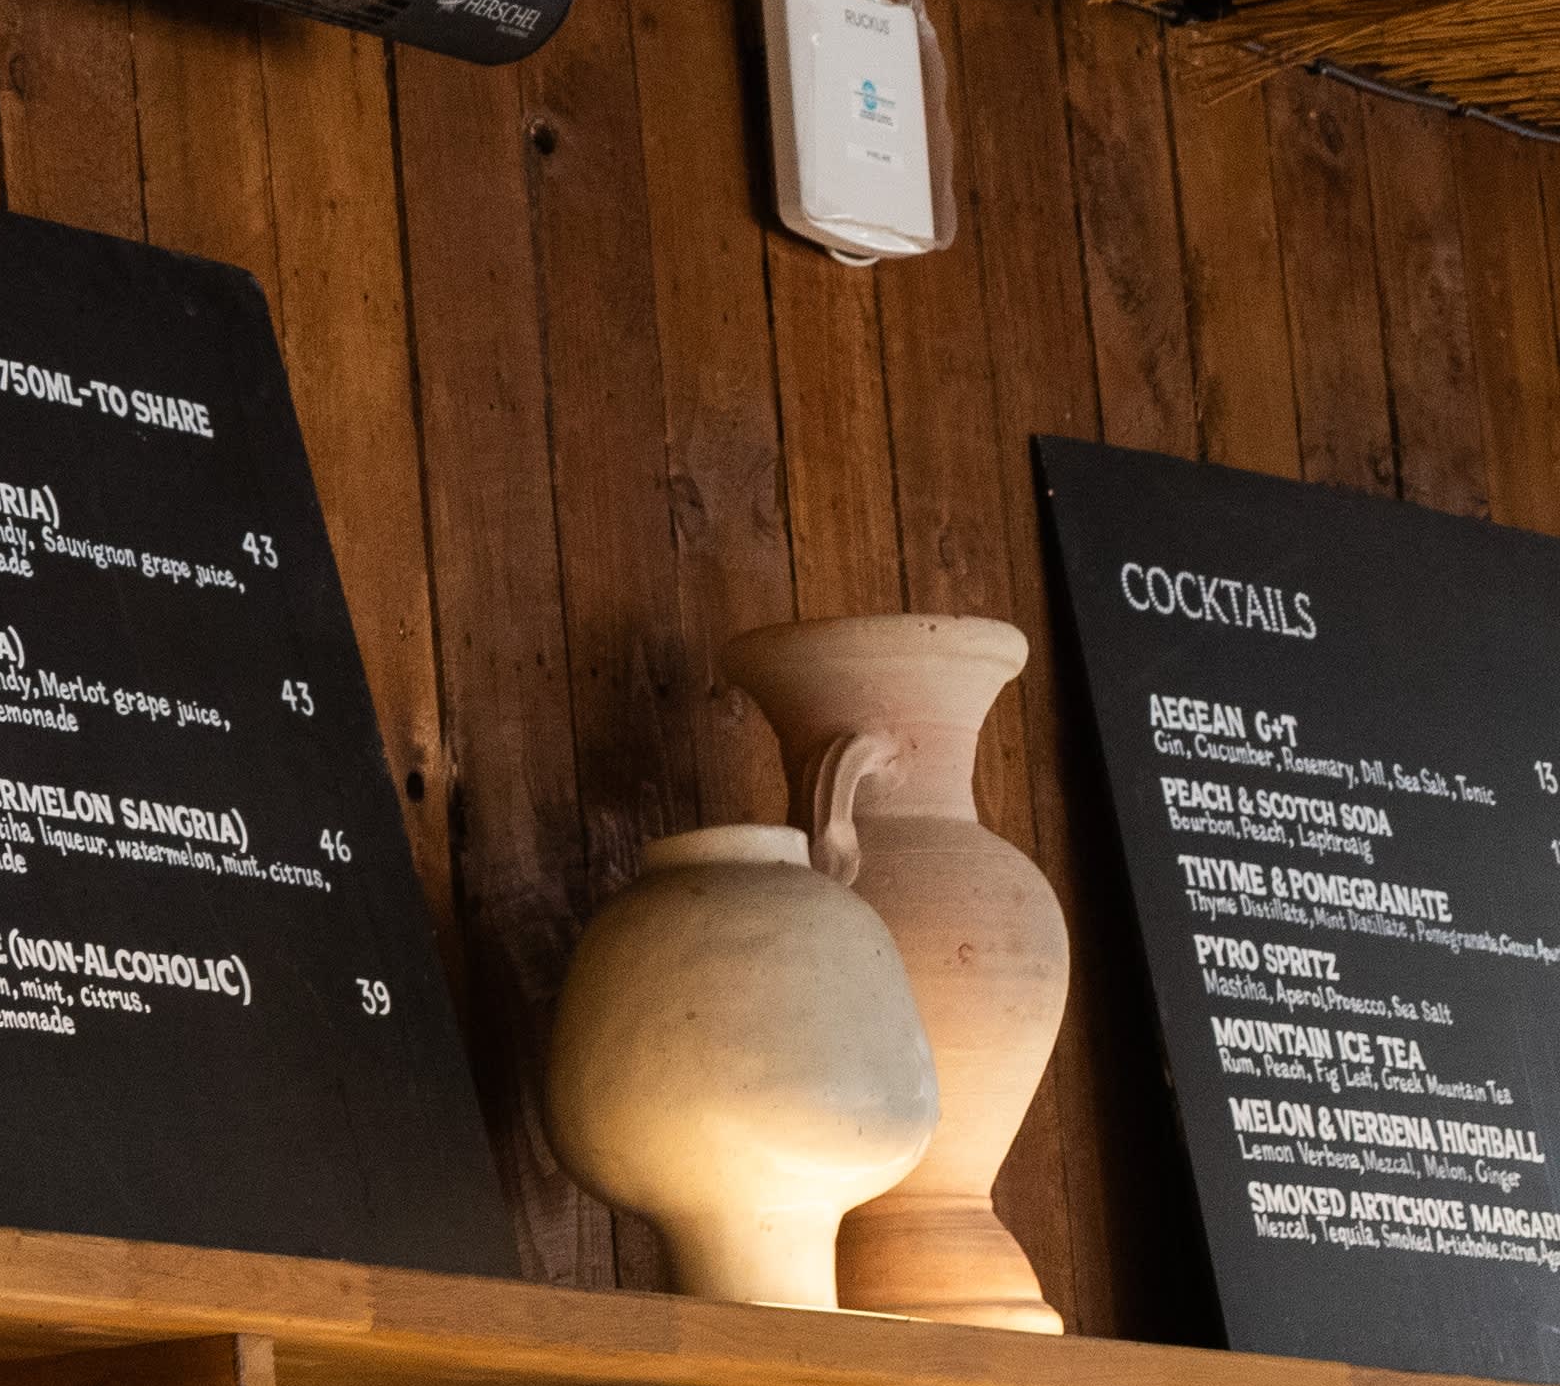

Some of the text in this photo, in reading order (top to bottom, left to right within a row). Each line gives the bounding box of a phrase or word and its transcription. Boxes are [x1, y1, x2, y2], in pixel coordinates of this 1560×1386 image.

[131, 390, 213, 437] SHARE
[243, 532, 278, 568] 43
[1121, 563, 1316, 639] COCKTAILS
[282, 679, 314, 716] 43
[1151, 696, 1298, 748] AEGEAN G+T
[120, 798, 248, 853] SANGRIA)
[1160, 777, 1392, 837] PEACH & SCOTCH SODA
[37, 817, 114, 858] liqueur,
[320, 829, 351, 862] 46
[1178, 855, 1453, 922] THYME & POMEGRANATE
[9, 928, 251, 1005] (NON-ALCOHOLIC)
[1194, 935, 1340, 981] PYRO SPRITZ
[356, 978, 390, 1015] 39
[1212, 1018, 1426, 1071] MOUNTAIN ICE TEA
[1229, 1098, 1545, 1163] MELON & VERBENA HIGHBALL
[1249, 1181, 1467, 1228] SMOKED ARTICHOKE
